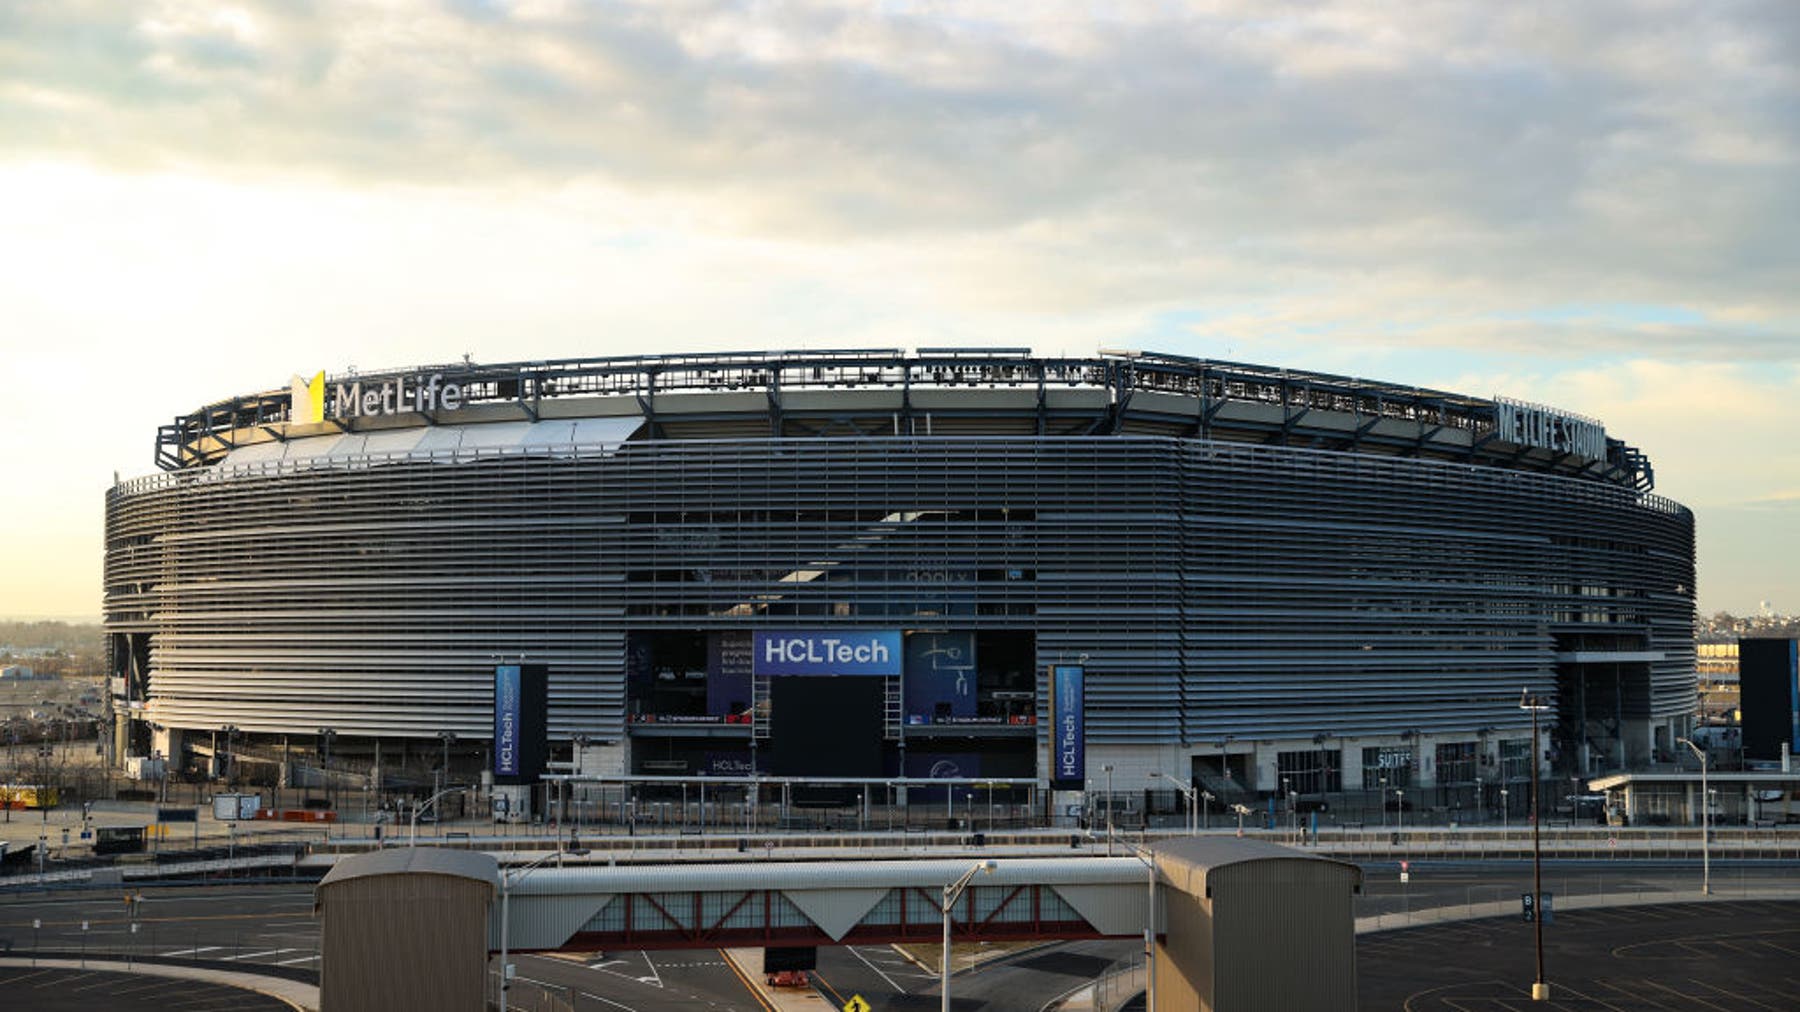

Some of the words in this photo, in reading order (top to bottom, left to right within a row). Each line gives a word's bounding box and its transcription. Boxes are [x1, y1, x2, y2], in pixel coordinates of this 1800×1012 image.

[336, 374, 460, 418] MetLife
[1499, 402, 1559, 450] METLIFE
[765, 639, 889, 662] HCLTech
[501, 712, 512, 772] HCLTech
[713, 760, 752, 770] HCLTec
[1063, 715, 1075, 776] HCLTech
